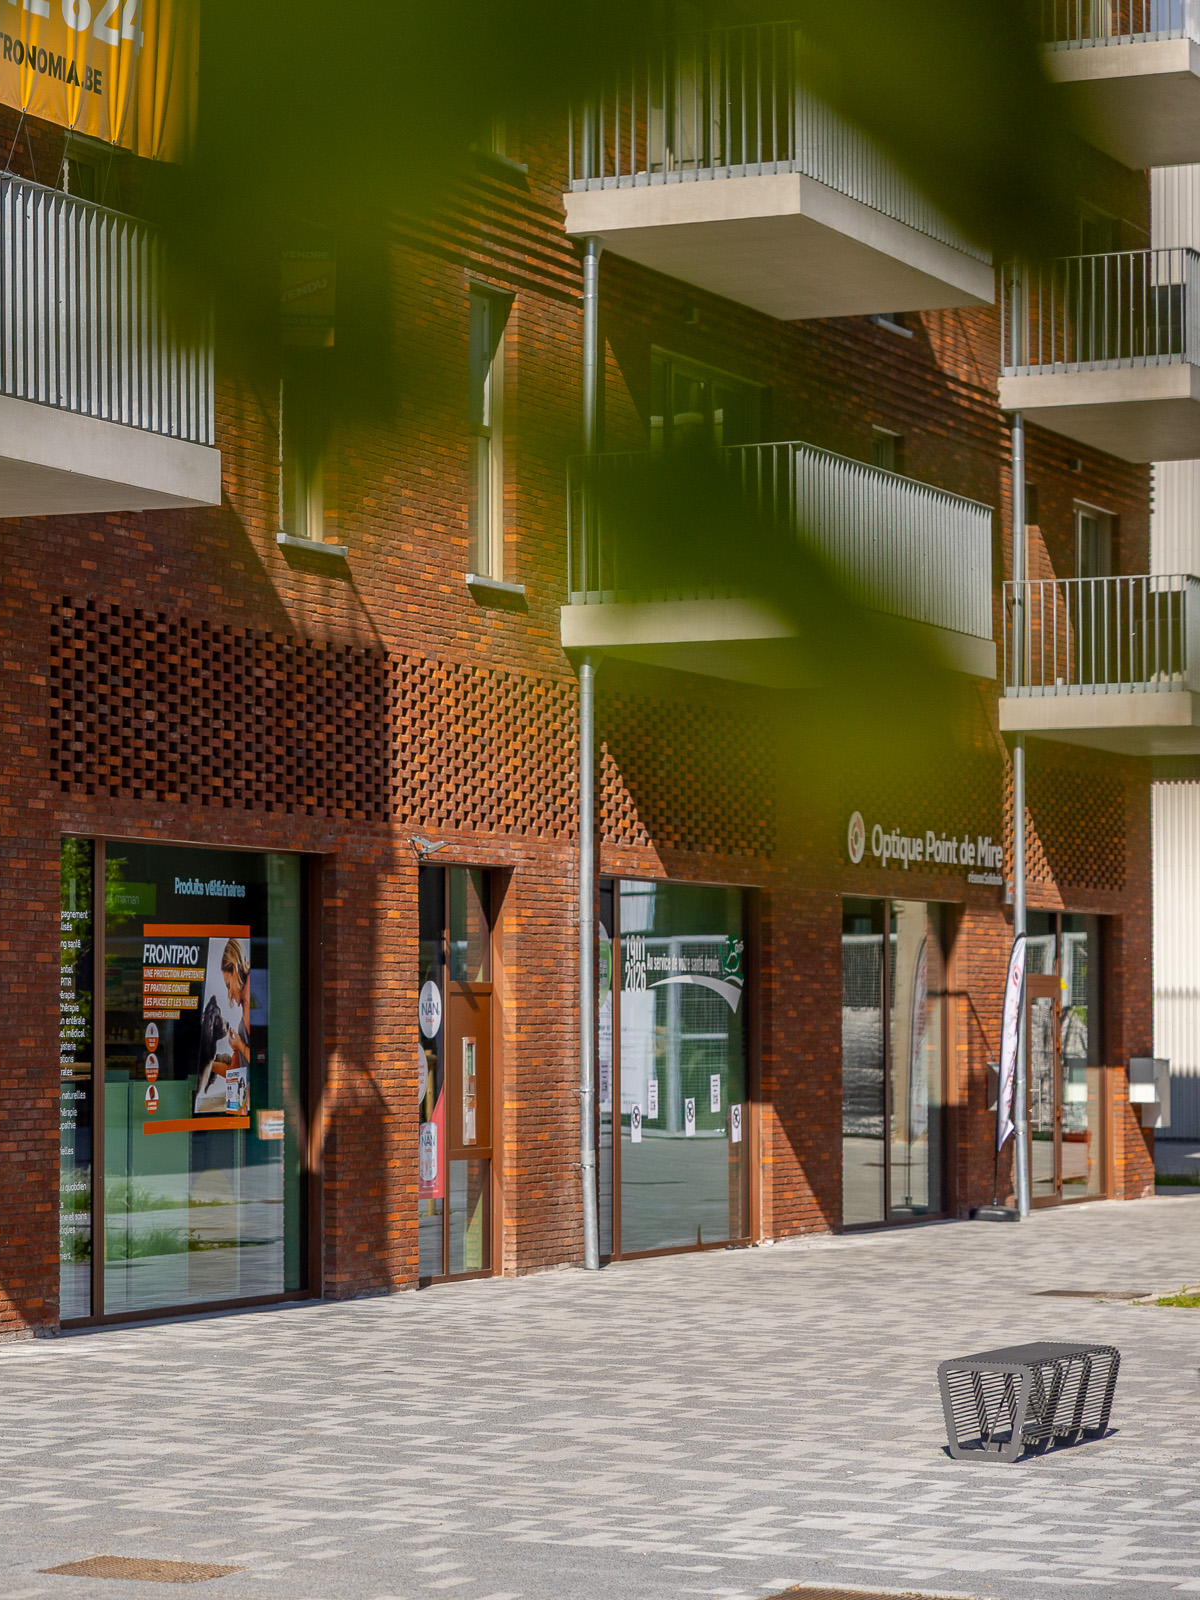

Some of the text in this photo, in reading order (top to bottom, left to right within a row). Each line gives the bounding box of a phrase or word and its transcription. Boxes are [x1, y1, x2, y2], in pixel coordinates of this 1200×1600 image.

[871, 823, 1004, 870] Optique Point de Mire
[174, 876, 247, 898] Produits vétérinaires
[142, 943, 199, 965] FRONTPRO
[654, 953, 671, 971] service
[153, 968, 180, 978] PROTECTION
[150, 983, 171, 993] PRATIQUE
[171, 983, 190, 993] CONTRE
[153, 997, 167, 1006] PUCES
[421, 1001, 439, 1015] NAN
